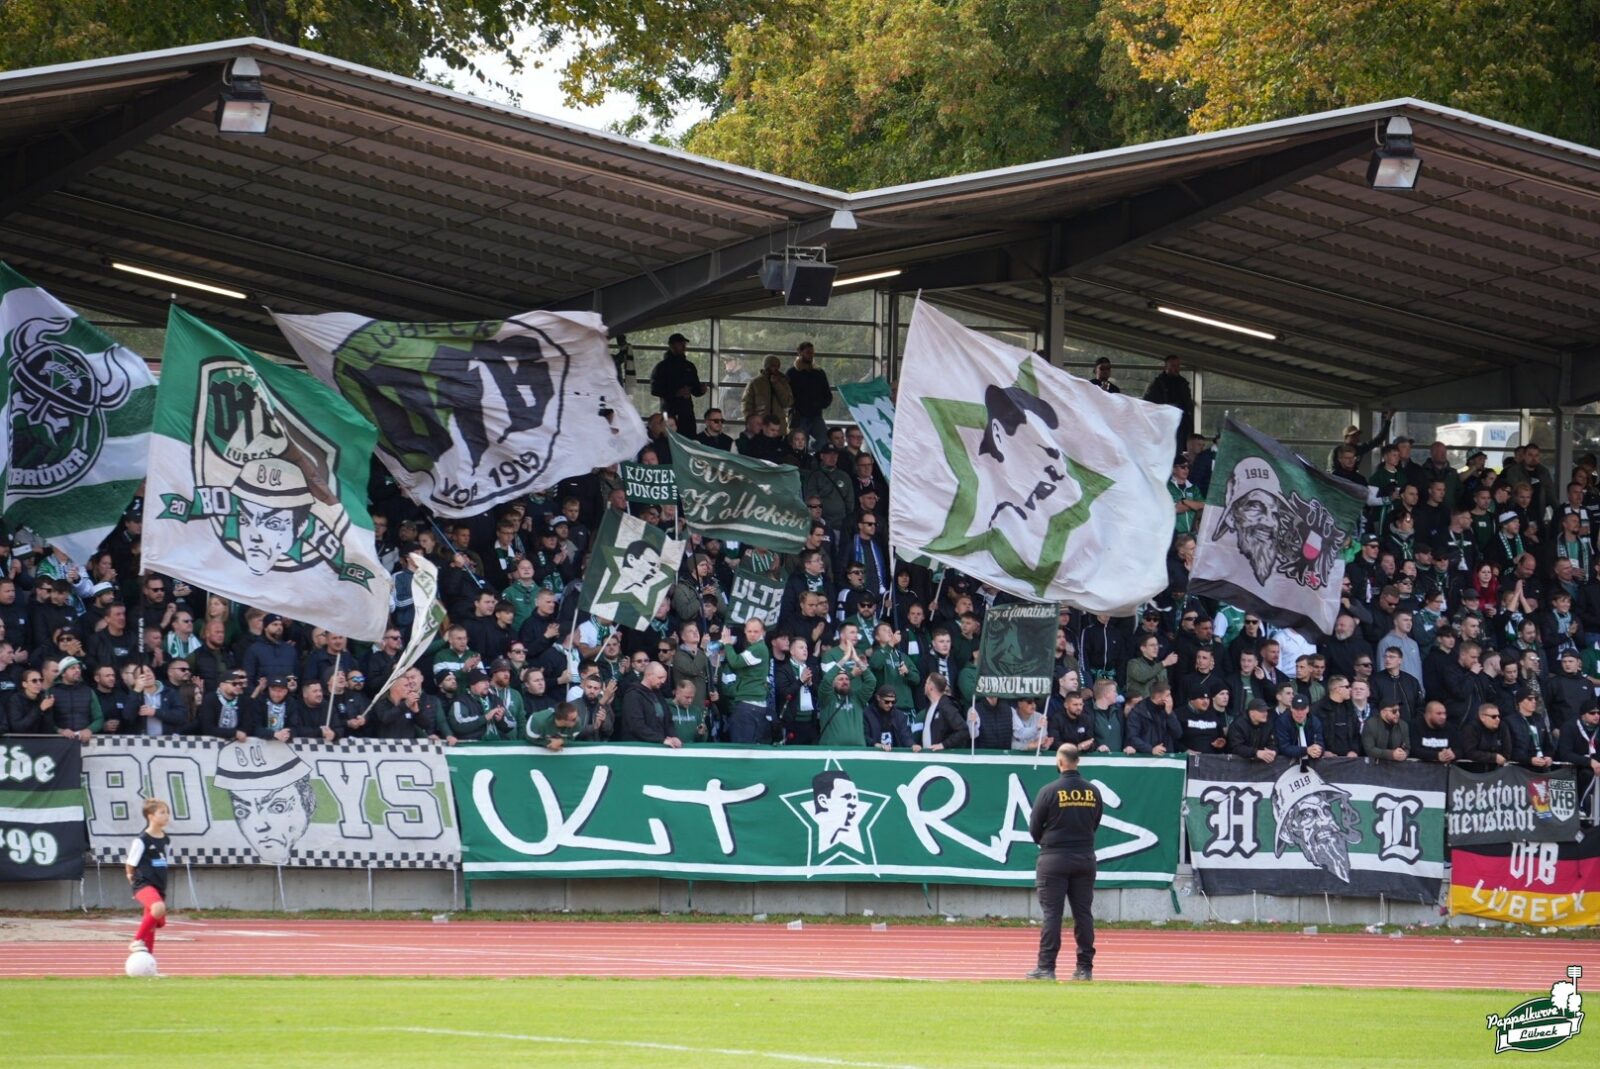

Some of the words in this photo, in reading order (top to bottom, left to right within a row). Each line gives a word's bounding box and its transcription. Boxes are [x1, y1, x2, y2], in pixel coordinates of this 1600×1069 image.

[11, 448, 88, 486] BRÜDER
[489, 451, 540, 487] 1919
[1245, 468, 1269, 480] 1919
[626, 483, 669, 500] JUNGS
[169, 500, 186, 515] 20
[1289, 775, 1312, 793] 1919
[1057, 789, 1097, 802] B.O.B.
[1550, 790, 1575, 810] VfB
[1509, 842, 1559, 887] VfB
[1471, 879, 1585, 922] LÜBECK
